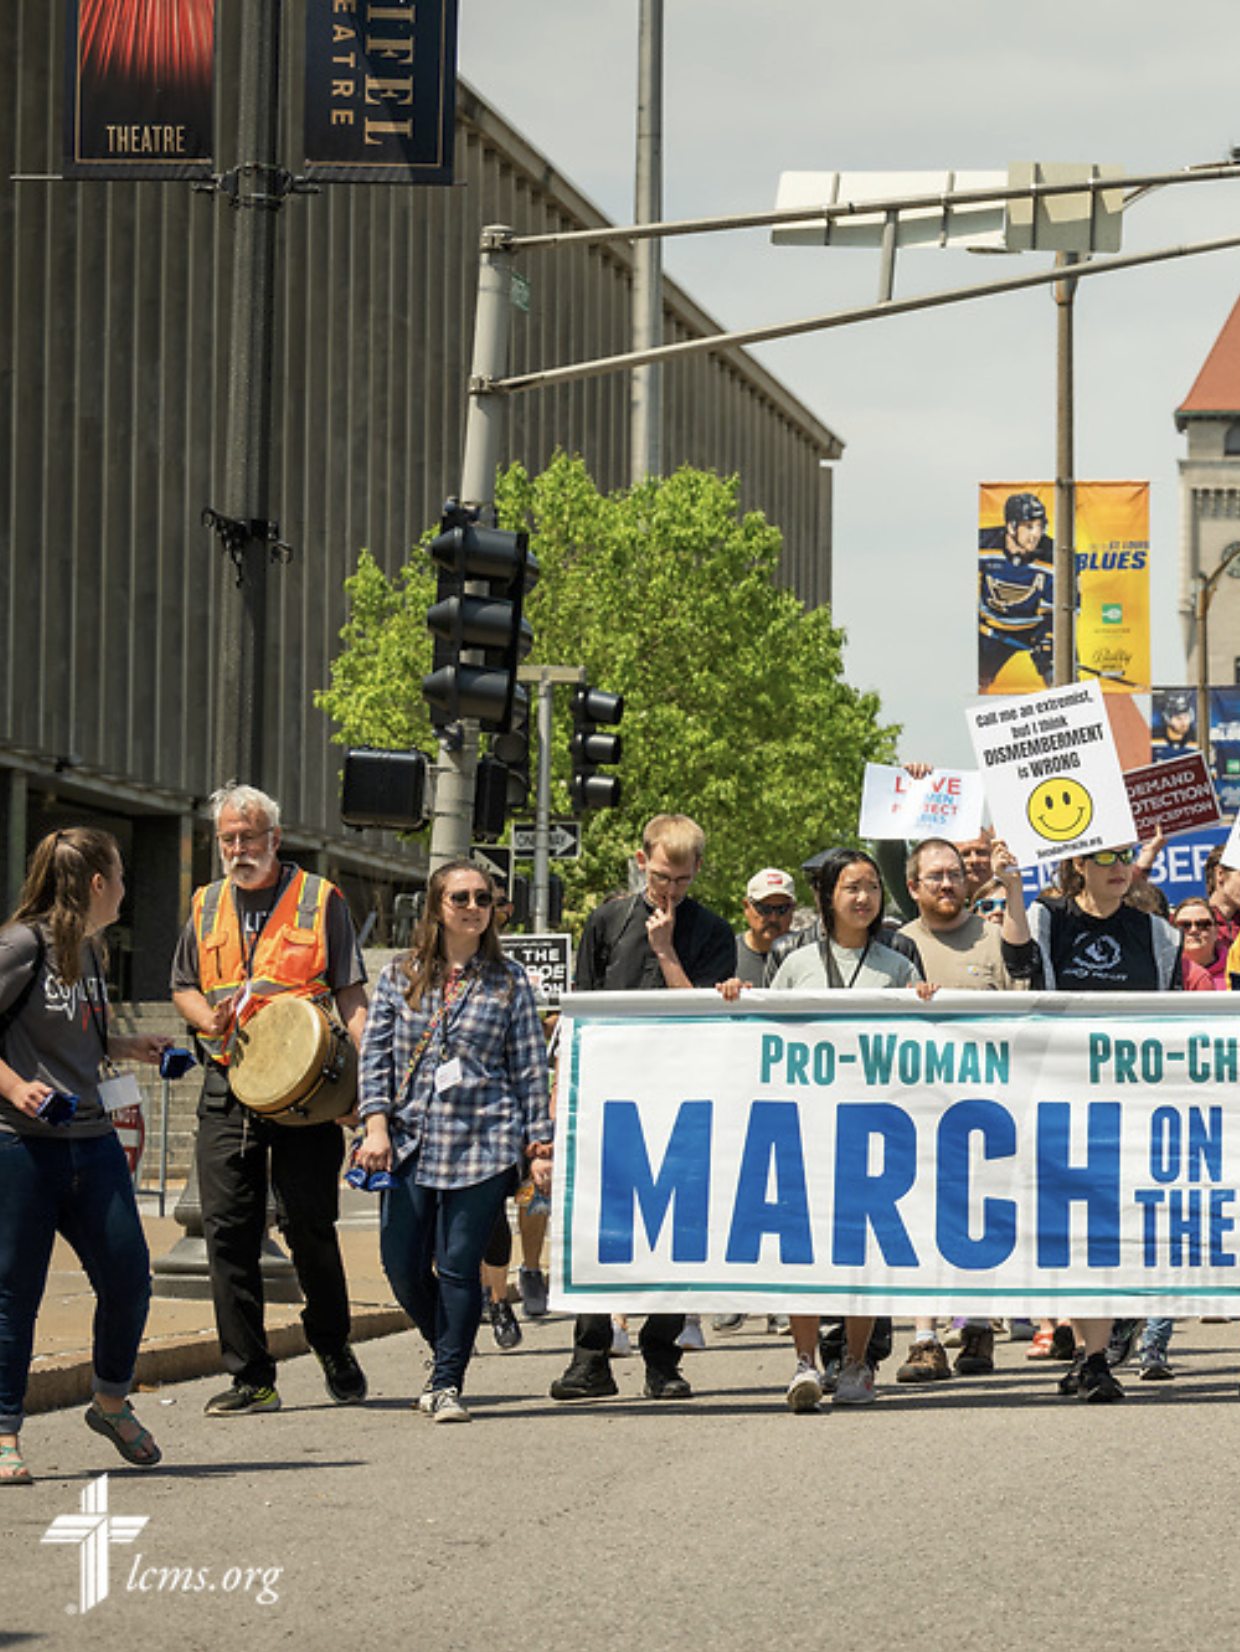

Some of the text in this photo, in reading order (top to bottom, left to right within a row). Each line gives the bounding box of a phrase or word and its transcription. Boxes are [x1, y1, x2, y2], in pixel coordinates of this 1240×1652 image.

[332, 0, 356, 126] EATRE
[365, 3, 415, 146] IFEL
[106, 125, 186, 153] THEATRE
[1075, 551, 1147, 571] BLUES
[1000, 708, 1018, 722] me
[1020, 704, 1034, 718] an
[1011, 715, 1068, 739] but I think
[984, 723, 1103, 766] DISMEMBERMENT
[1018, 752, 1081, 779] is WRONG
[895, 776, 961, 795] LVE
[1131, 782, 1210, 814] OTECTION
[522, 948, 560, 961] THE
[1150, 1105, 1222, 1184] ON
[598, 1099, 1121, 1270] MARCH
[1134, 1188, 1236, 1268] THE
